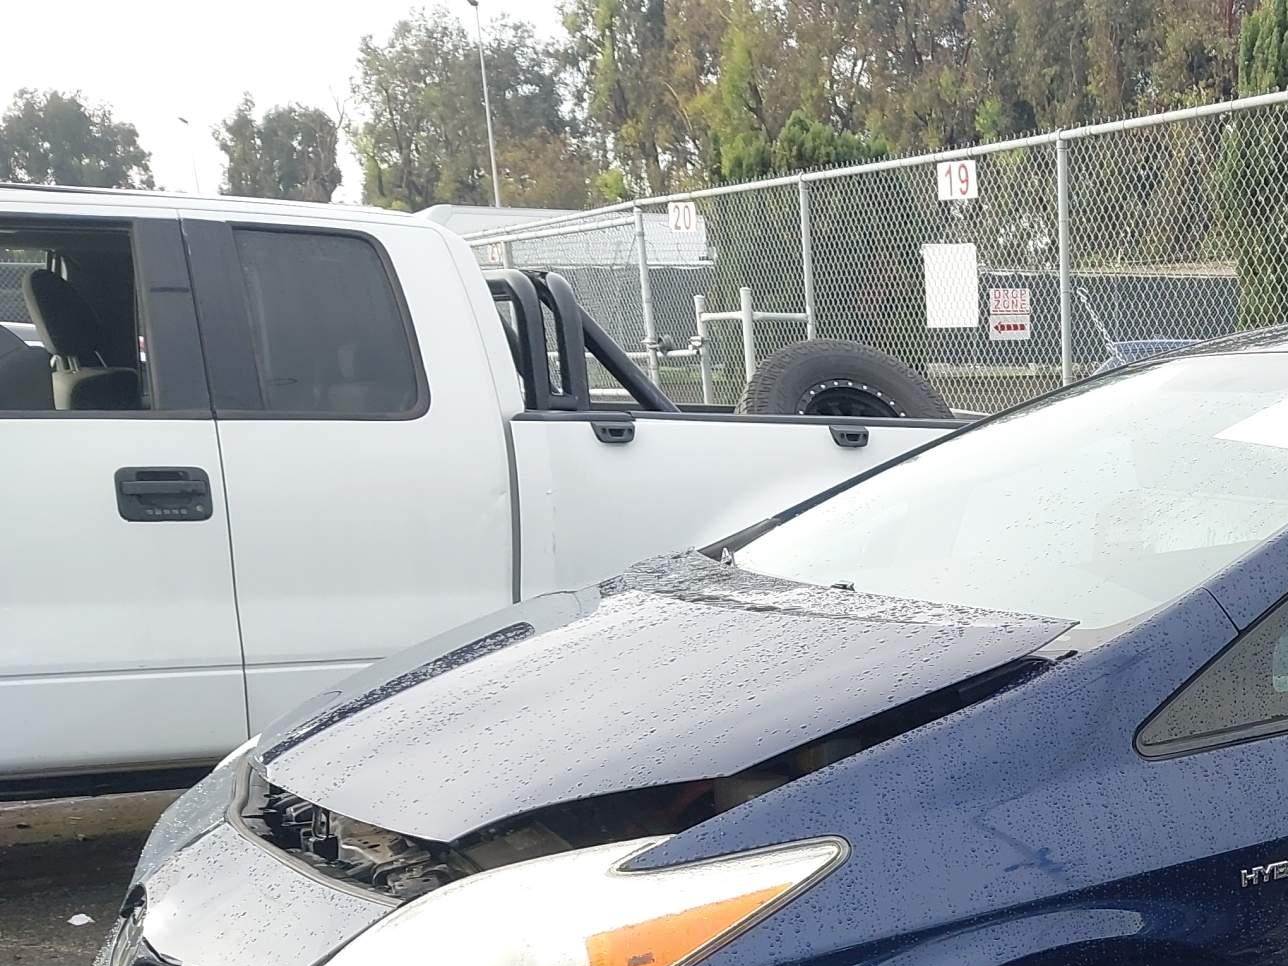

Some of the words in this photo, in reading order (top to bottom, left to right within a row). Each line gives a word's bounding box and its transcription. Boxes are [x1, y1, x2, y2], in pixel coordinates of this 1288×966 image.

[945, 163, 969, 197] 19
[673, 204, 692, 231] 20
[993, 289, 1027, 300] DROP
[993, 299, 1027, 310] ZONE
